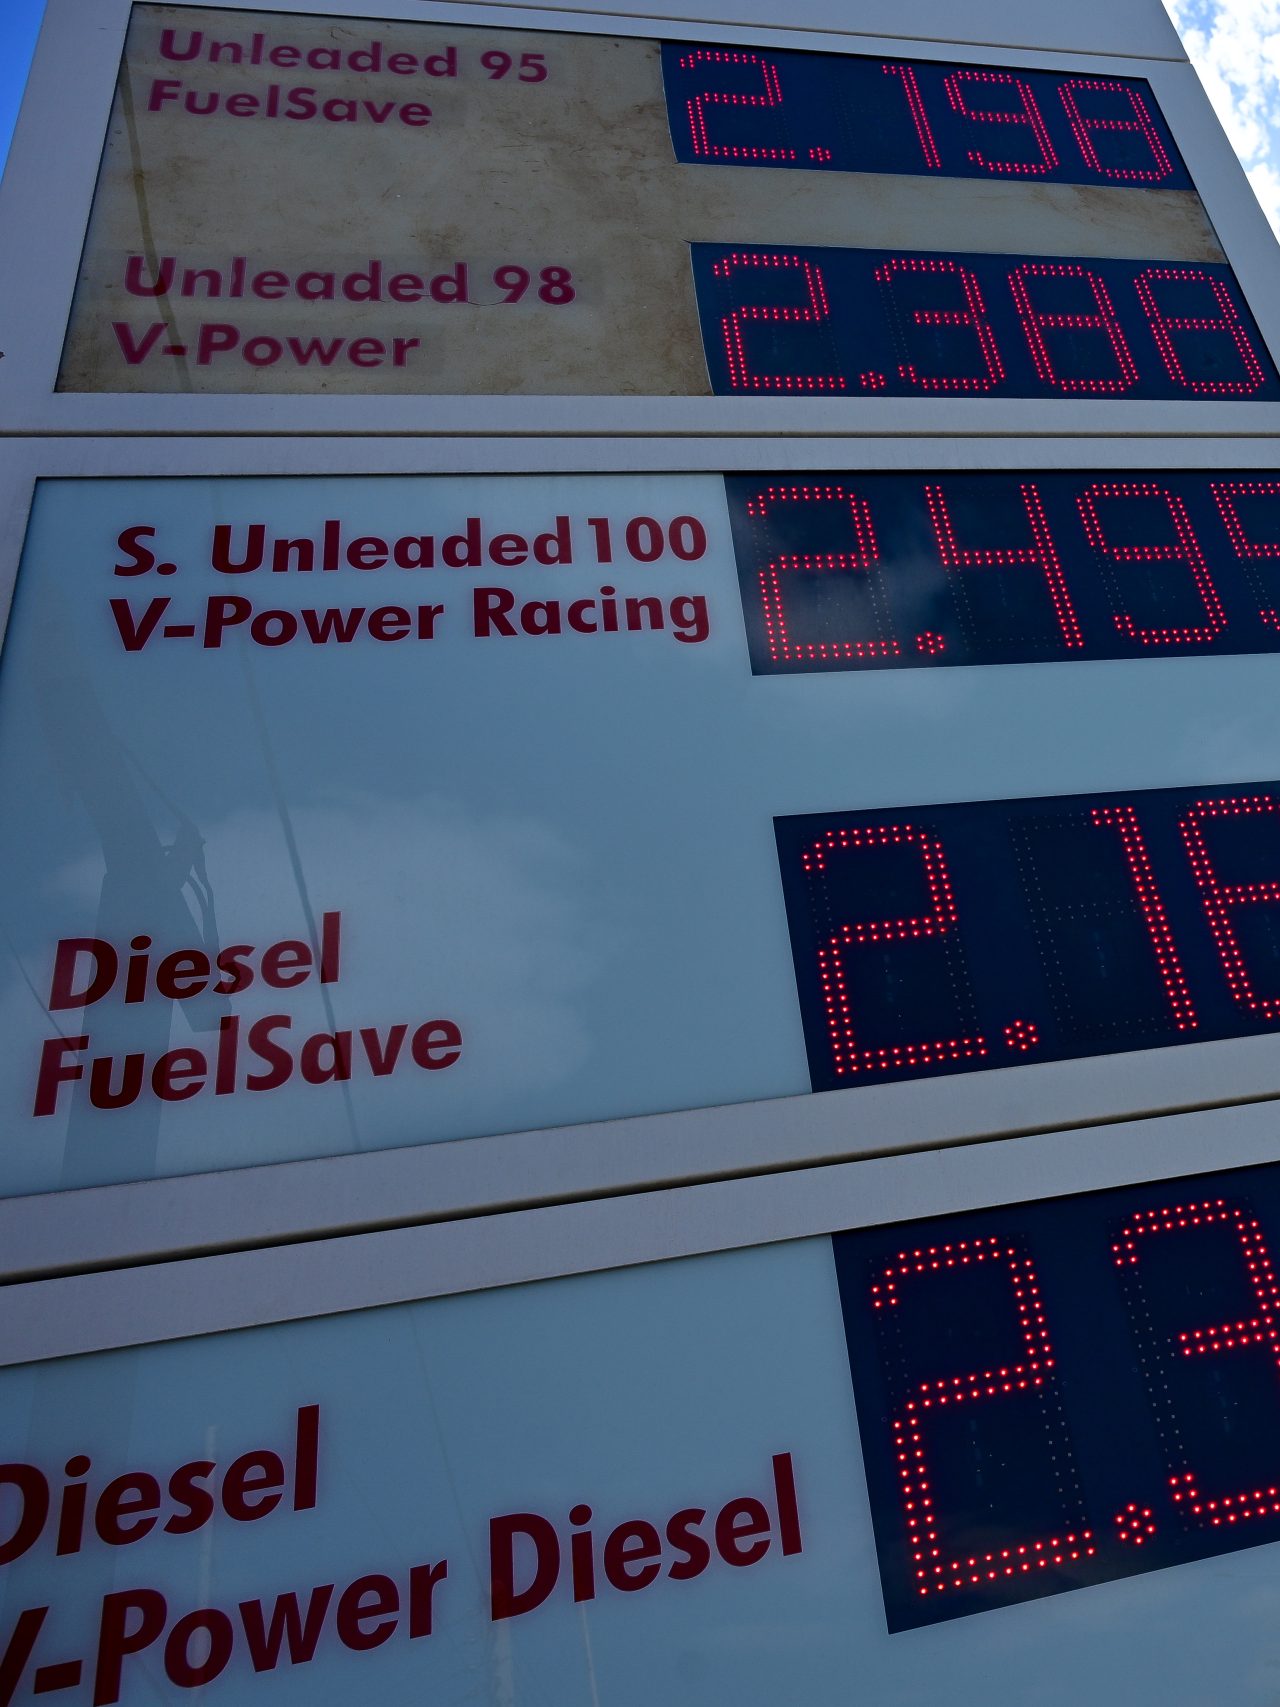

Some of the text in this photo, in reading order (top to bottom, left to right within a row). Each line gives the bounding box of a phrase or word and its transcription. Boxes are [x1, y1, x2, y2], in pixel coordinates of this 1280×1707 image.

[155, 29, 549, 84] Unleaded 95
[147, 79, 433, 127] FuelSave
[680, 50, 1173, 180] 2.198
[125, 256, 577, 305] Unleaded 98
[112, 321, 421, 368] V-Power
[713, 253, 1265, 393] 2.388
[114, 515, 708, 577] S. Unleaded 100
[110, 586, 711, 652] V-Power Racing
[48, 910, 341, 1012] Diesel
[32, 1014, 463, 1117] FuelSave
[489, 1451, 803, 1622] Diesel
